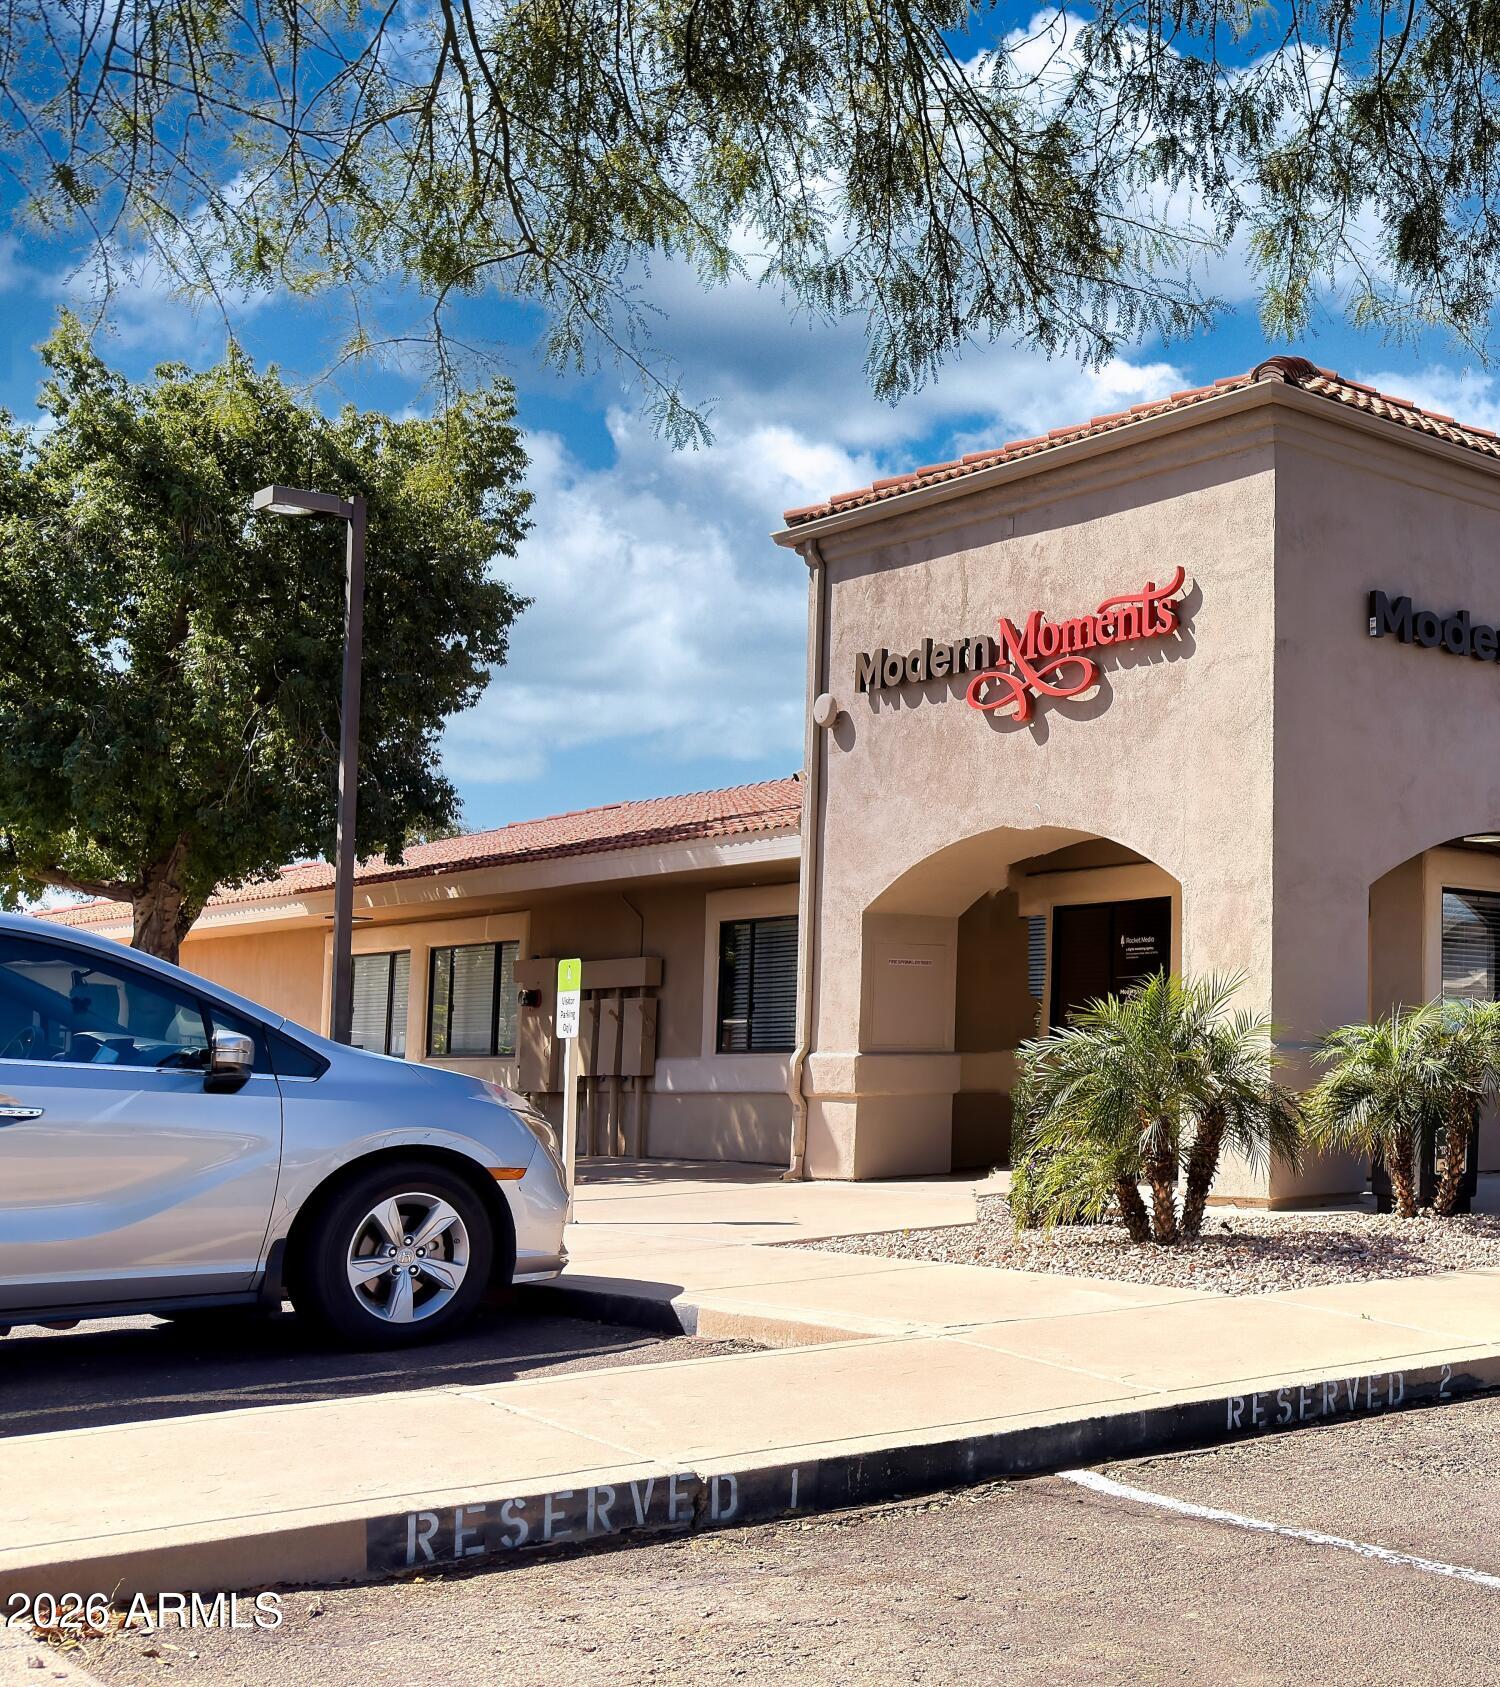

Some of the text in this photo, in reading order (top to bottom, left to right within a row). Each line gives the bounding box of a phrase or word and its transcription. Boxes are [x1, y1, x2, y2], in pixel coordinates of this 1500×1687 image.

[855, 566, 1186, 722] Modern Moments
[1125, 936, 1140, 944] Rocket
[561, 996, 575, 1006] Visitor
[560, 1010, 576, 1021] Parking
[562, 1023, 573, 1034] Only
[1226, 1365, 1452, 1430] RESERVED 2
[406, 1468, 799, 1564] RESERVED 1
